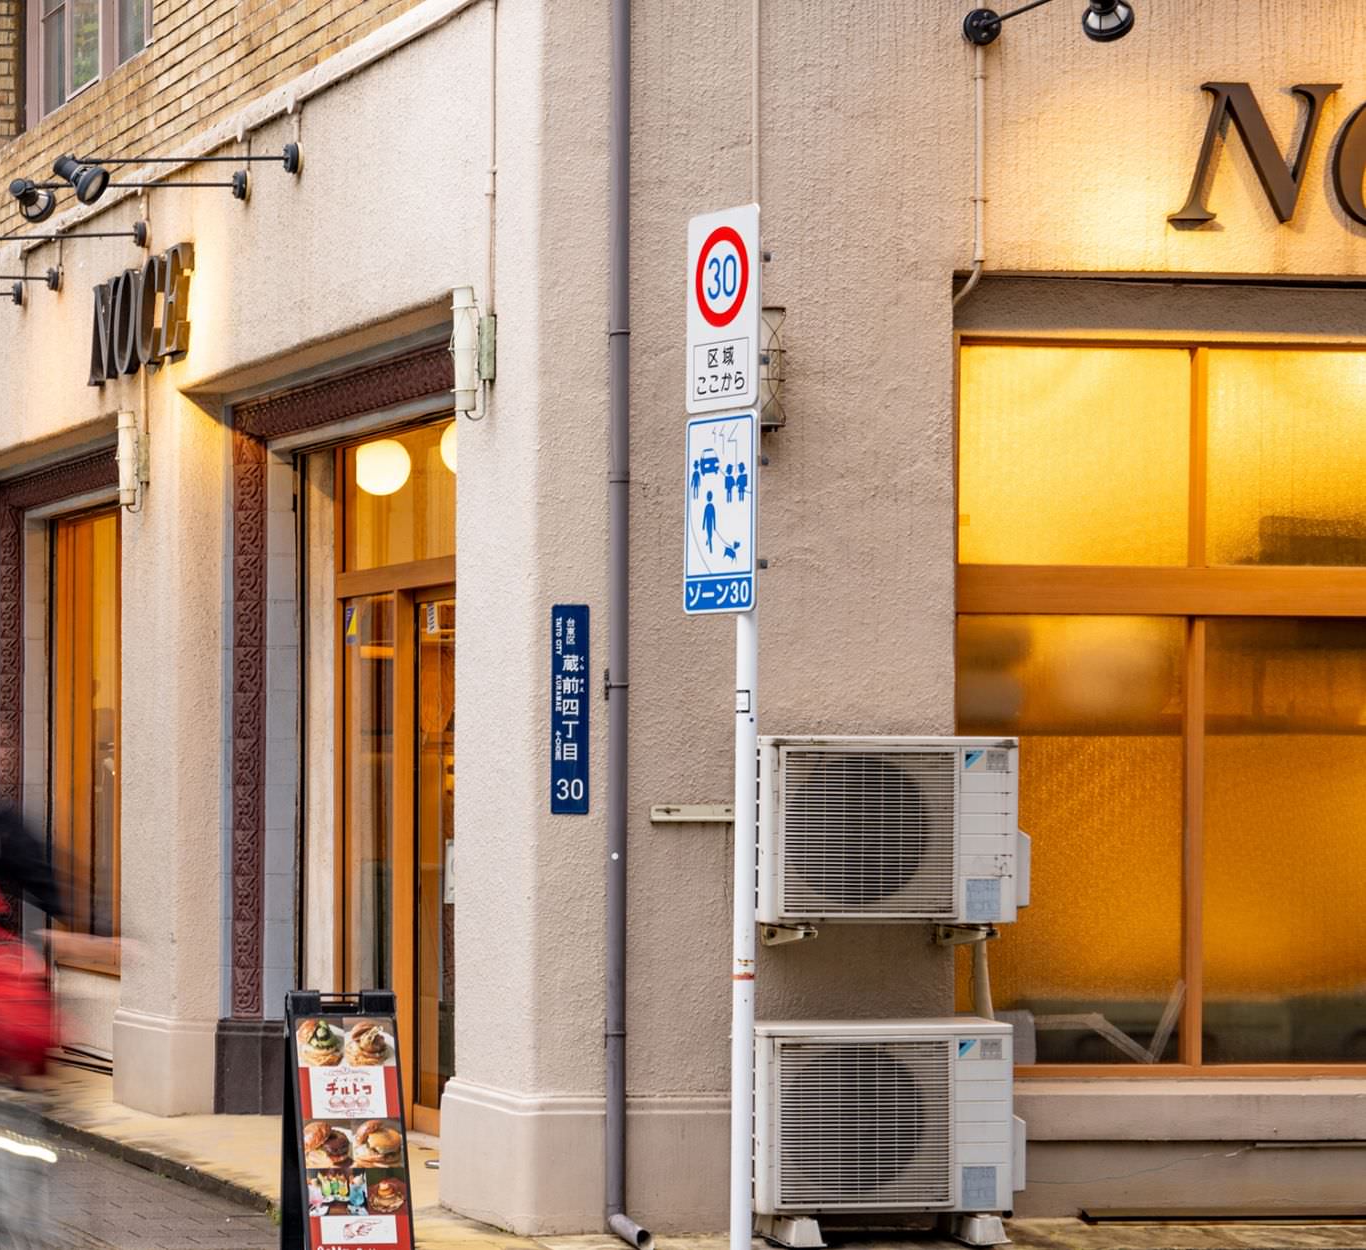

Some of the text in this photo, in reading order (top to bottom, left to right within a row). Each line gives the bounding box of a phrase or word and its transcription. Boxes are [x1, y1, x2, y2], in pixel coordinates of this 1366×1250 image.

[1167, 82, 1366, 225] N
[707, 254, 738, 301] 30
[88, 242, 195, 387] NOCE
[707, 346, 735, 369] 区域
[696, 371, 746, 396] ここから
[688, 580, 750, 608] ゾーン30
[555, 616, 563, 638] TAITO
[562, 654, 580, 761] 蔵前四丁目
[556, 778, 584, 800] 30
